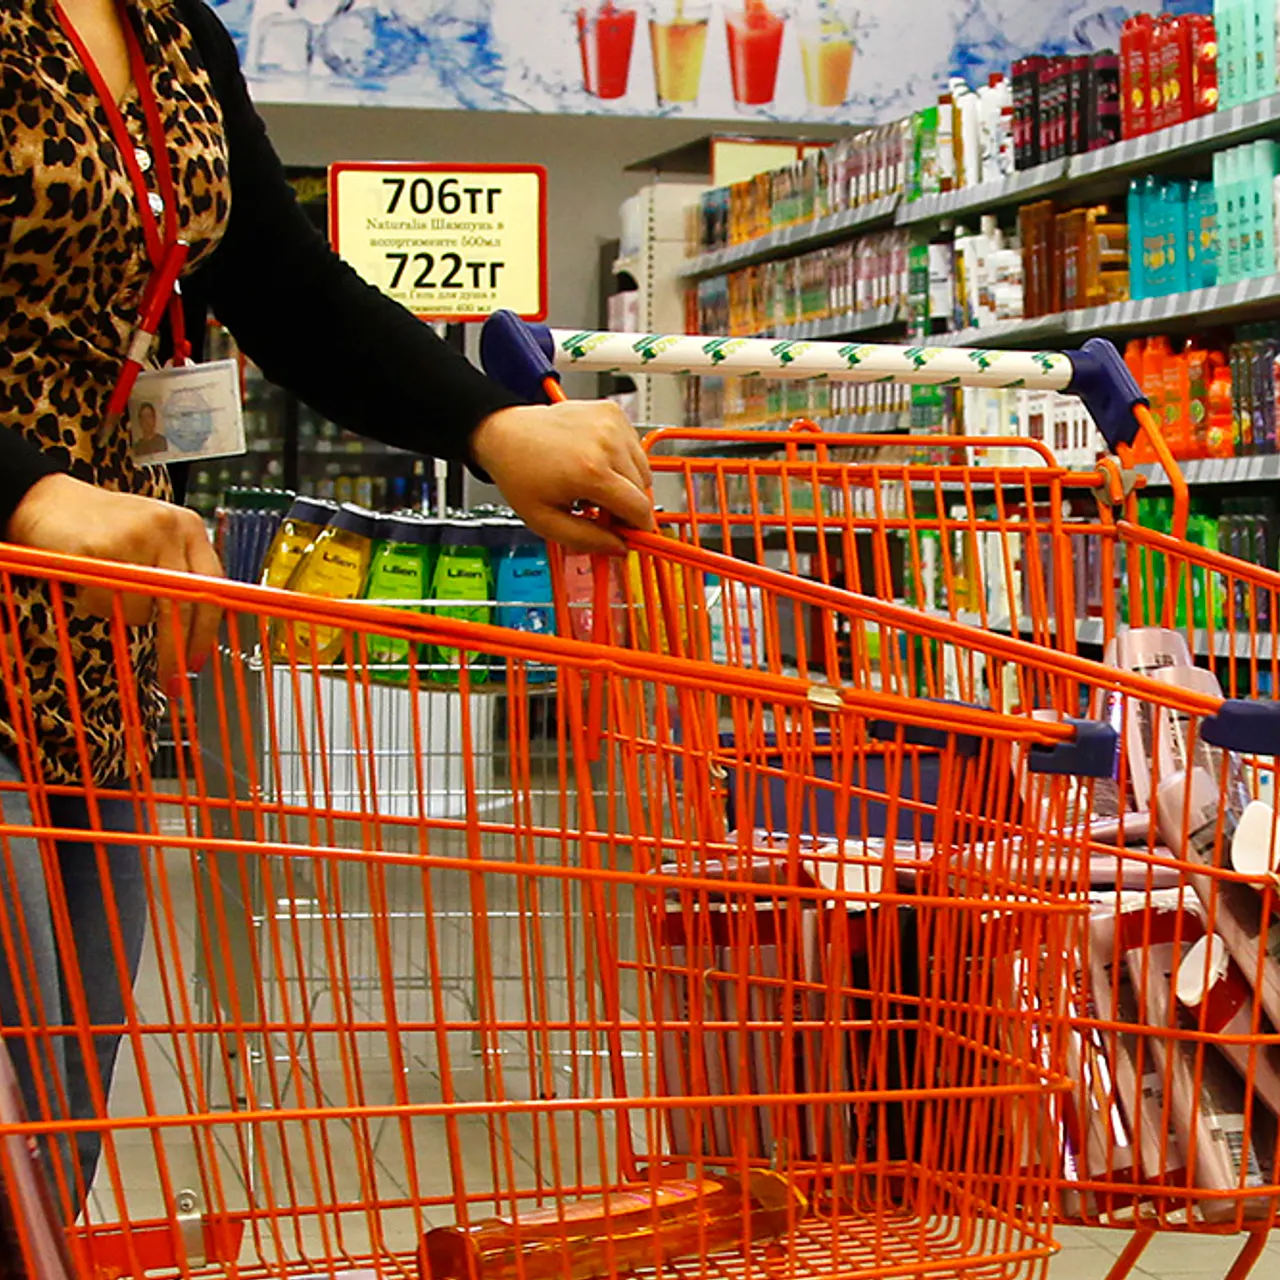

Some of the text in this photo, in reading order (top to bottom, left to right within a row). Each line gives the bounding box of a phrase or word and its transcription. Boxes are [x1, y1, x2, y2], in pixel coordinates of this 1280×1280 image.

[382, 178, 502, 214] 706тг
[385, 252, 505, 288] 722тг
[382, 564, 417, 578] Lilien
[447, 567, 482, 580] Lilien
